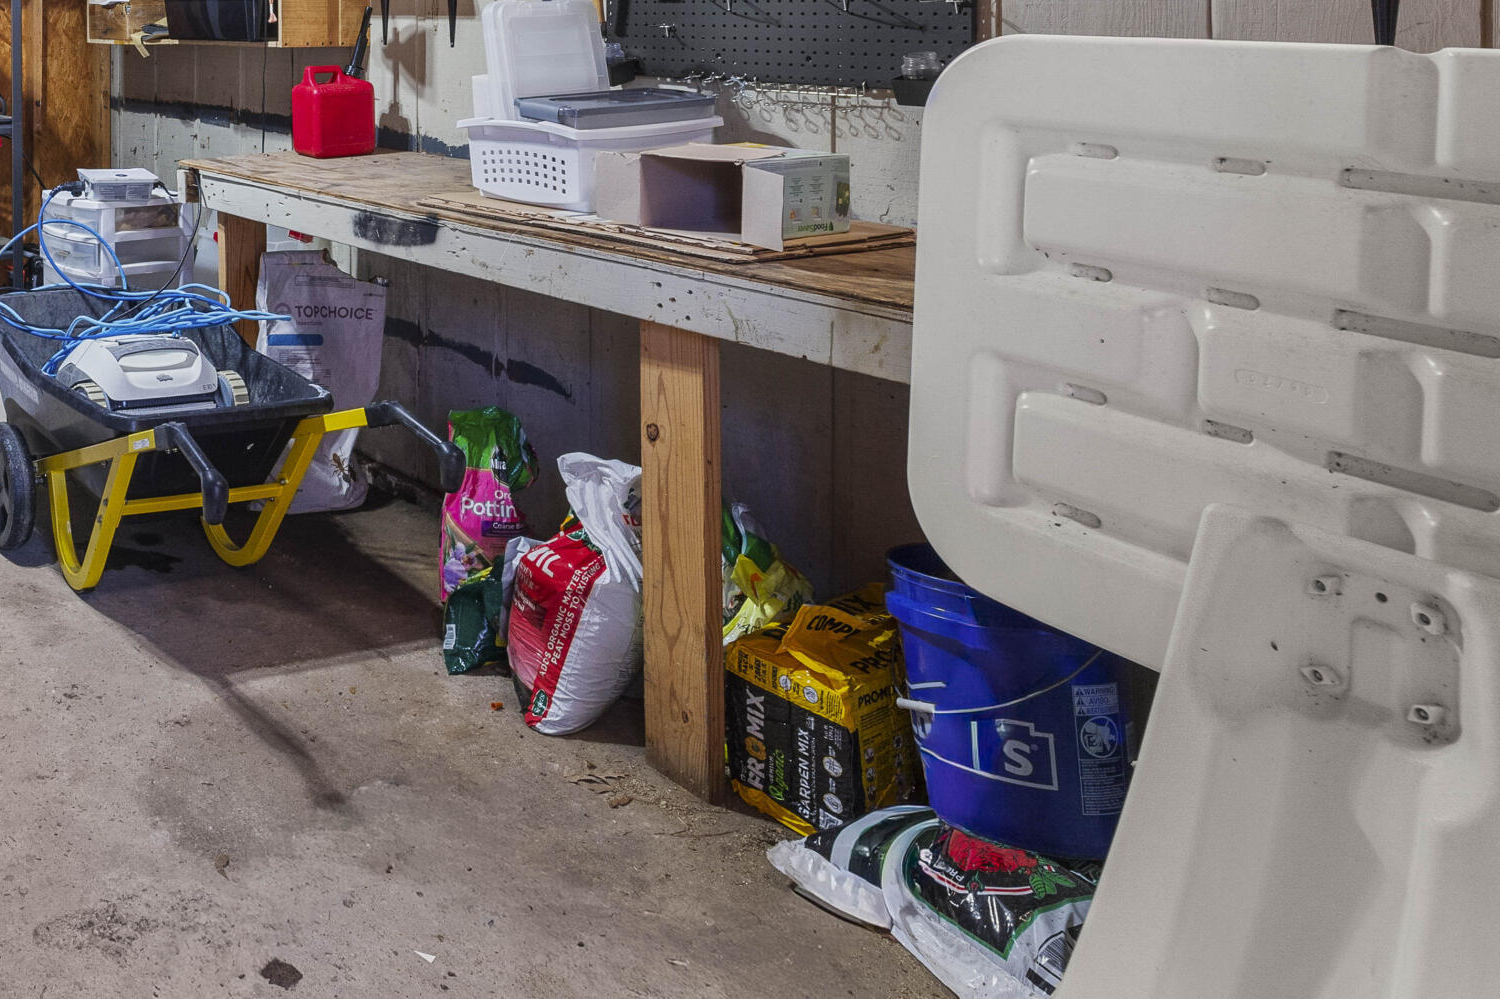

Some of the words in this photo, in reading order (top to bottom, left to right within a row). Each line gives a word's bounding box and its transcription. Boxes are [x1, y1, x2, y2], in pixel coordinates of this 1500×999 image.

[295, 304, 373, 321] TOPCHOICE
[461, 496, 518, 519] Pottin
[539, 651, 552, 677] ADDS
[547, 605, 567, 651] ORGANIC
[562, 569, 582, 605] MATTER
[551, 640, 565, 666] PEAT
[560, 611, 575, 639] MOSS
[569, 594, 580, 609] TO
[576, 562, 601, 595] EXISTING
[798, 727, 810, 757] MIX
[798, 761, 811, 820] GARDEN
